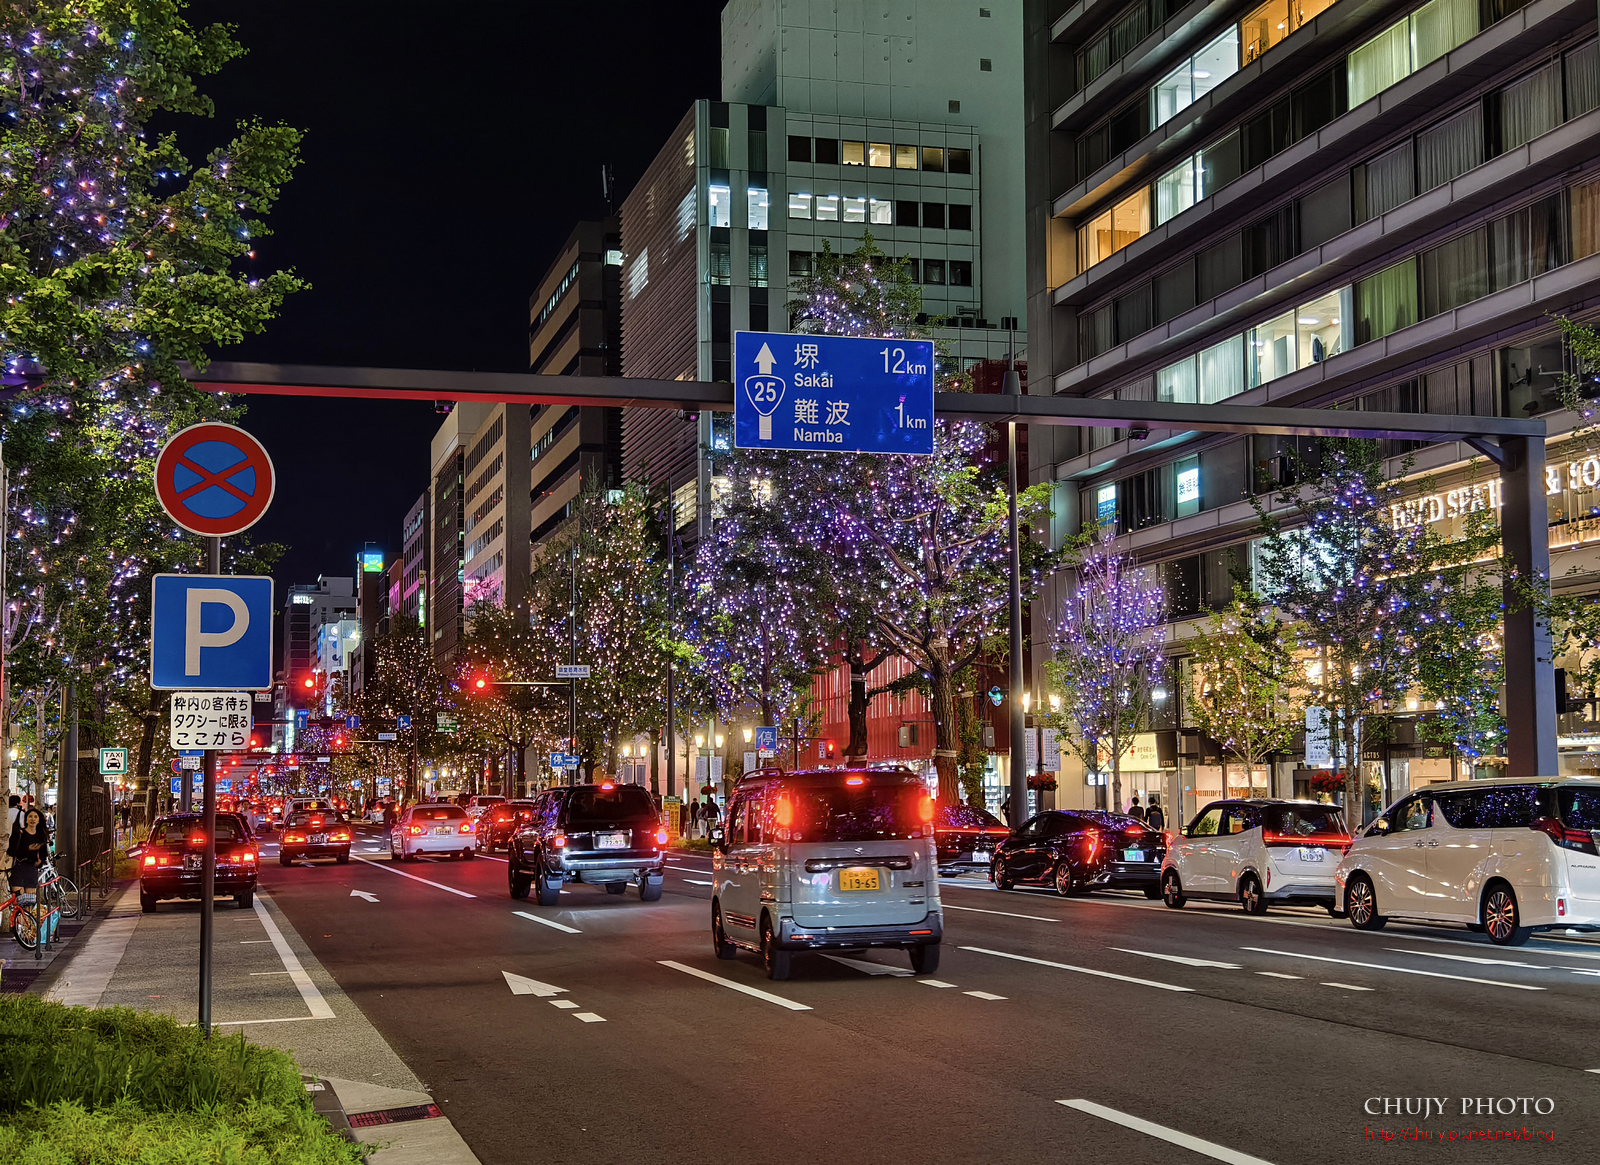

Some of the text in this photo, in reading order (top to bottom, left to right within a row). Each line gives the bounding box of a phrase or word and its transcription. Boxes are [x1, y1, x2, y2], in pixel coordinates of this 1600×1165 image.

[794, 344, 927, 375] 堺 12km
[794, 373, 834, 388] Sakai
[754, 382, 777, 402] 25
[794, 399, 927, 429] 難波 1km
[794, 428, 843, 443] Namba
[185, 587, 250, 676] P
[174, 696, 248, 711] 枠内の客待ち
[174, 714, 248, 729] タクシーに限る
[176, 731, 246, 746] ここから
[758, 730, 774, 746] 停
[849, 878, 877, 889] 19-65
